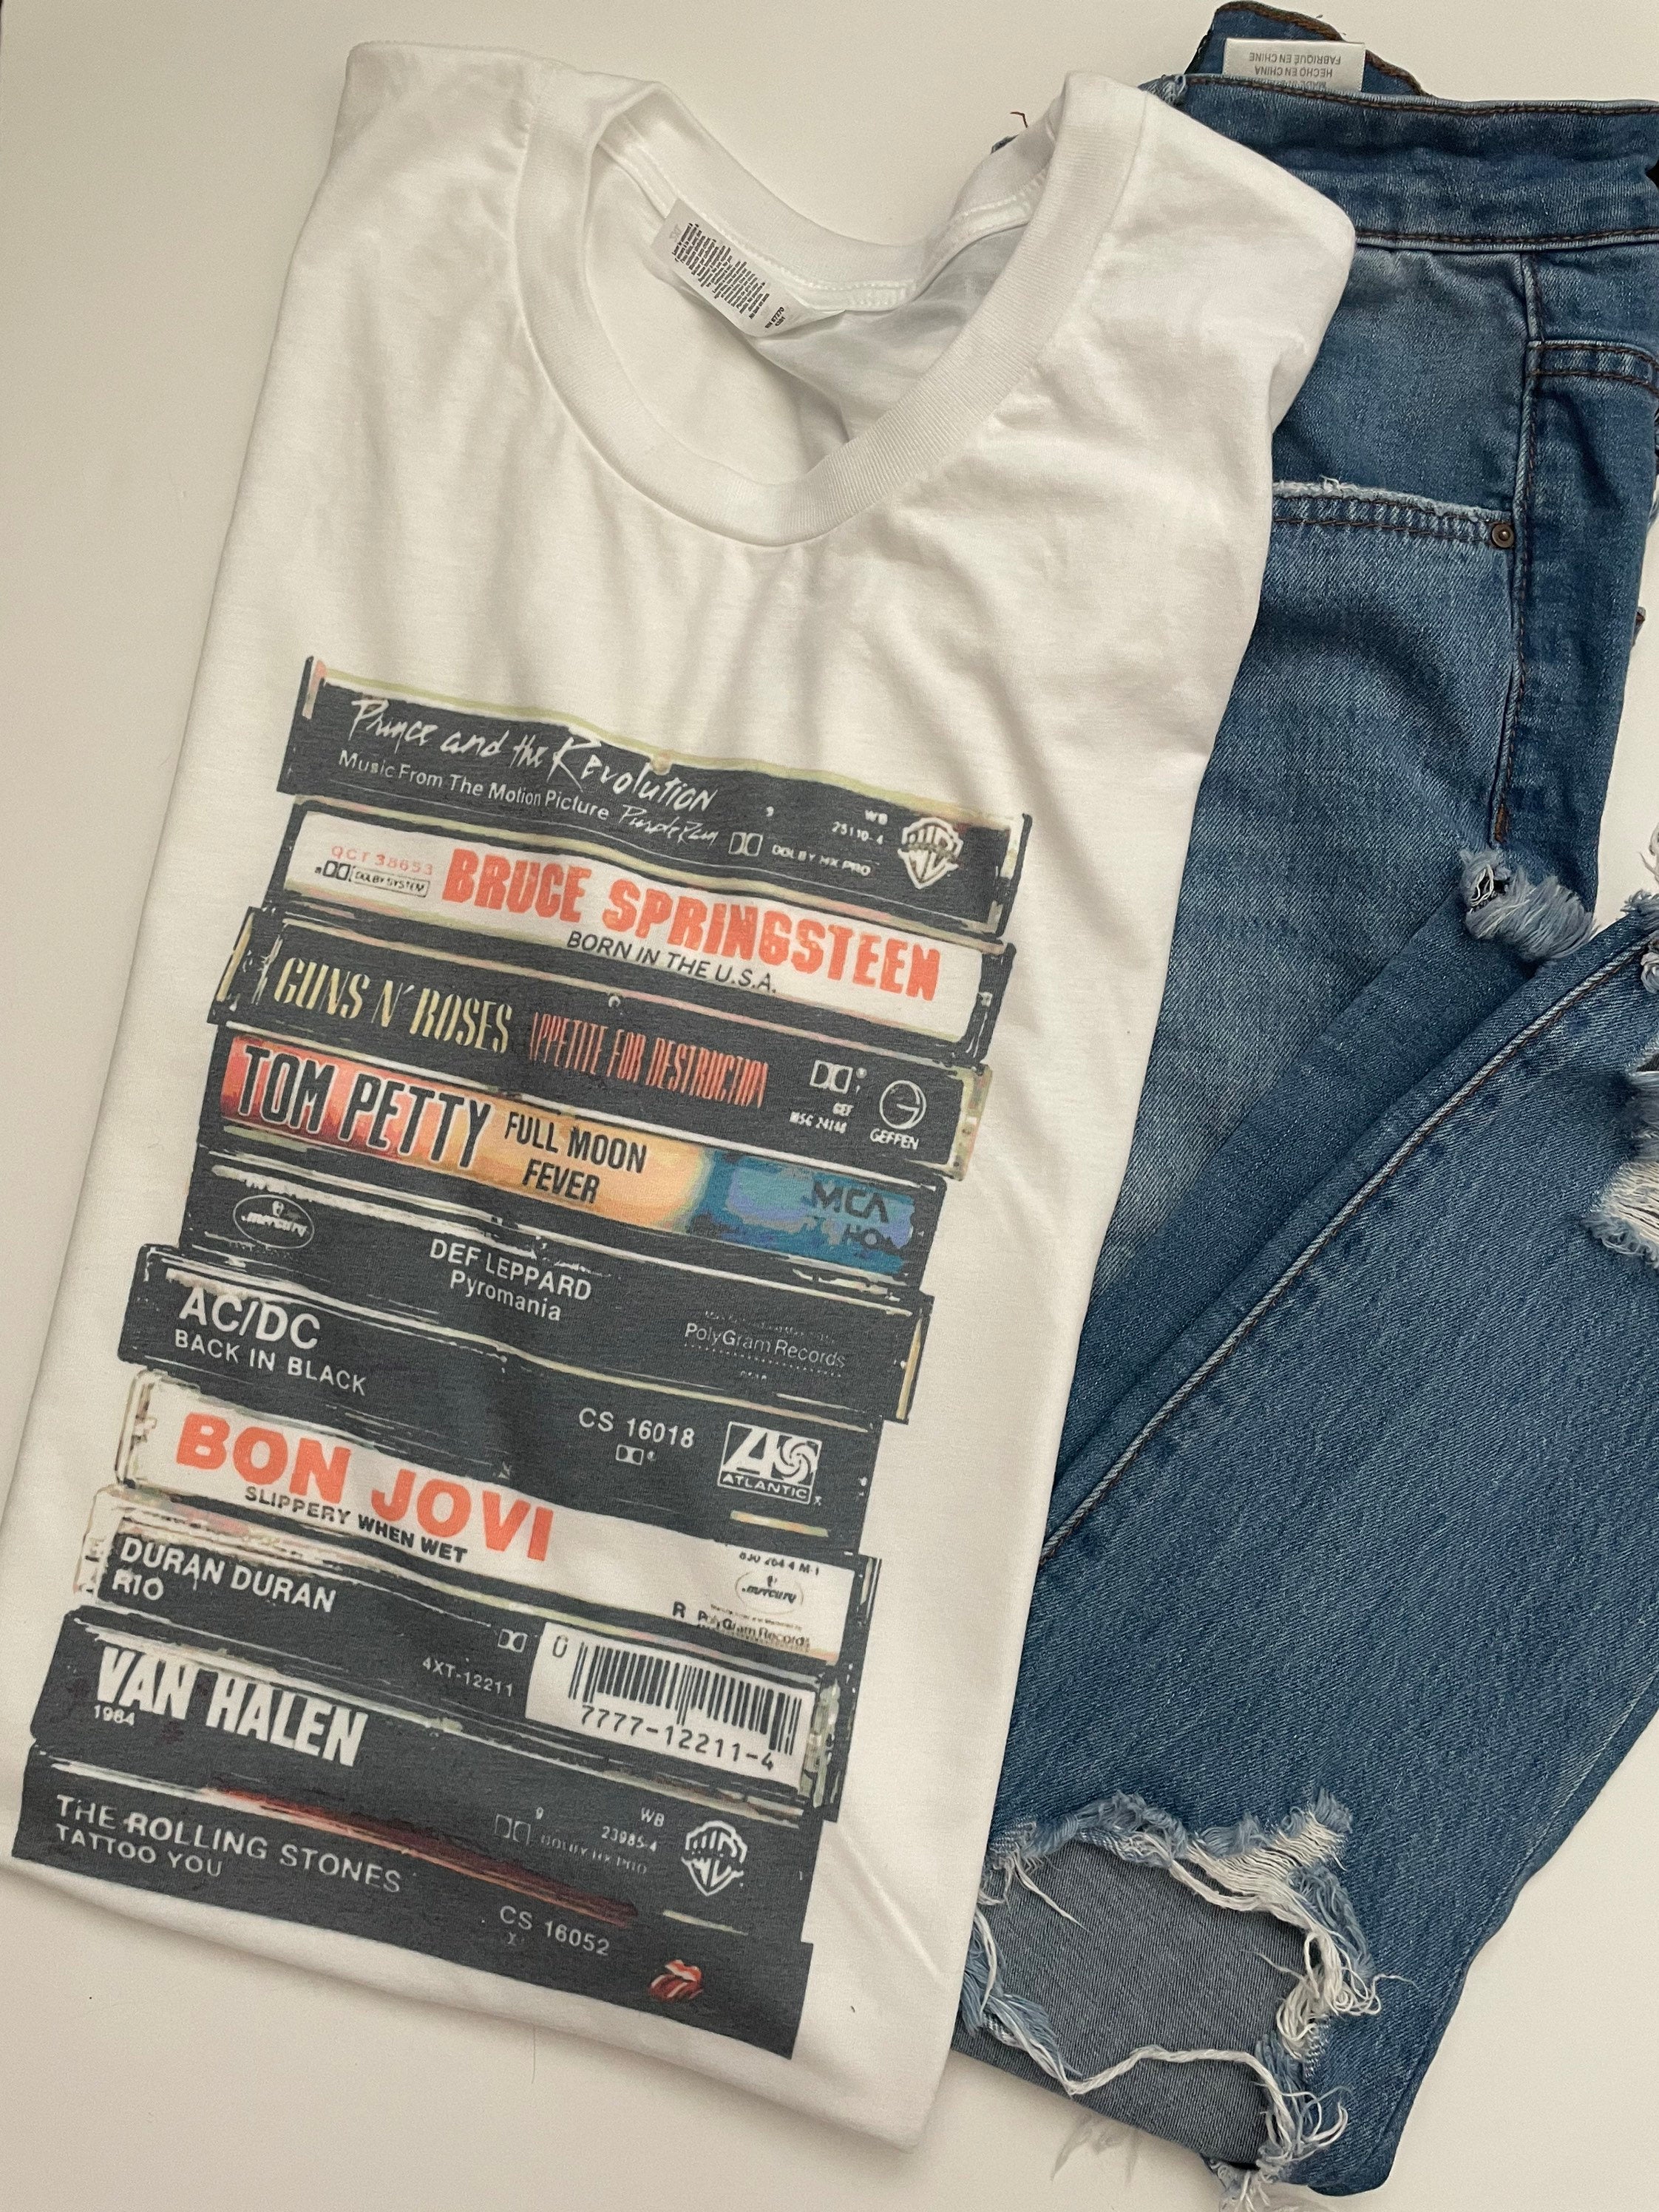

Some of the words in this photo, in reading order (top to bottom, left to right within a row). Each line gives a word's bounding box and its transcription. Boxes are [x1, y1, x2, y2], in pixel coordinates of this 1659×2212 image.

[1249, 52, 1277, 63] CHINE
[1255, 65, 1283, 75] CHINA
[1279, 54, 1292, 64] EN
[1285, 66, 1297, 76] EN
[1293, 52, 1341, 65] FABRIQUÉ
[1299, 67, 1332, 78] HECHO
[440, 730, 508, 759] and
[513, 734, 547, 769] the
[339, 750, 396, 778] Music
[398, 764, 444, 789] From
[449, 774, 484, 798] The
[489, 781, 541, 807] Motion
[545, 793, 610, 821] Picture
[441, 848, 593, 923] BRUCE
[602, 879, 940, 1002] SPRINGSTEEN
[567, 931, 633, 961] BORN
[636, 946, 662, 967] IN
[668, 951, 713, 981] THE
[715, 964, 777, 994] U.S.A.
[274, 957, 372, 1020] GUNS
[410, 988, 514, 1054] ROSES
[237, 1044, 336, 1136] TOM
[339, 1070, 494, 1173] PETTY
[505, 1111, 559, 1154] FULL
[567, 1125, 648, 1174] MOON
[869, 1127, 920, 1150] GEFFEN
[523, 1158, 600, 1204] FEVER
[813, 1181, 889, 1224] MCA
[430, 1238, 481, 1266] DEF
[485, 1252, 591, 1300] LEPPARD
[178, 1287, 321, 1350] AC/DC
[449, 1269, 562, 1321] Pyromania
[174, 1329, 240, 1363] BACK
[249, 1348, 276, 1372] IN
[287, 1355, 367, 1397] BLACK
[685, 1323, 771, 1354] PolyGram
[774, 1339, 846, 1368] Records
[578, 1407, 615, 1433] CS
[626, 1418, 695, 1449] 16018
[176, 1411, 352, 1504] BON
[370, 1468, 554, 1562] JOVI
[722, 1473, 809, 1500] ATLANTIC
[245, 1485, 352, 1526] SLIPPERY
[356, 1515, 415, 1549] WHEN
[419, 1536, 469, 1564] WET
[112, 1568, 164, 1601] RIO
[118, 1538, 225, 1584] DURAN
[230, 1567, 337, 1613] DURAN
[552, 1635, 568, 1659] 0
[421, 1656, 513, 1697] 4XT-12211
[94, 1704, 136, 1727] 1984
[96, 1646, 200, 1720] VAN
[205, 1673, 368, 1767] HALEN
[580, 1704, 775, 1771] 7777-12211-4
[641, 1807, 665, 1827] WB
[55, 1822, 157, 1864] TATTOO
[168, 1850, 223, 1878] YOU
[56, 1794, 118, 1830] THE
[125, 1811, 268, 1860] ROLLING
[279, 1843, 401, 1893] STONES
[500, 1905, 534, 1931] CS
[544, 1920, 611, 1958] 16052
